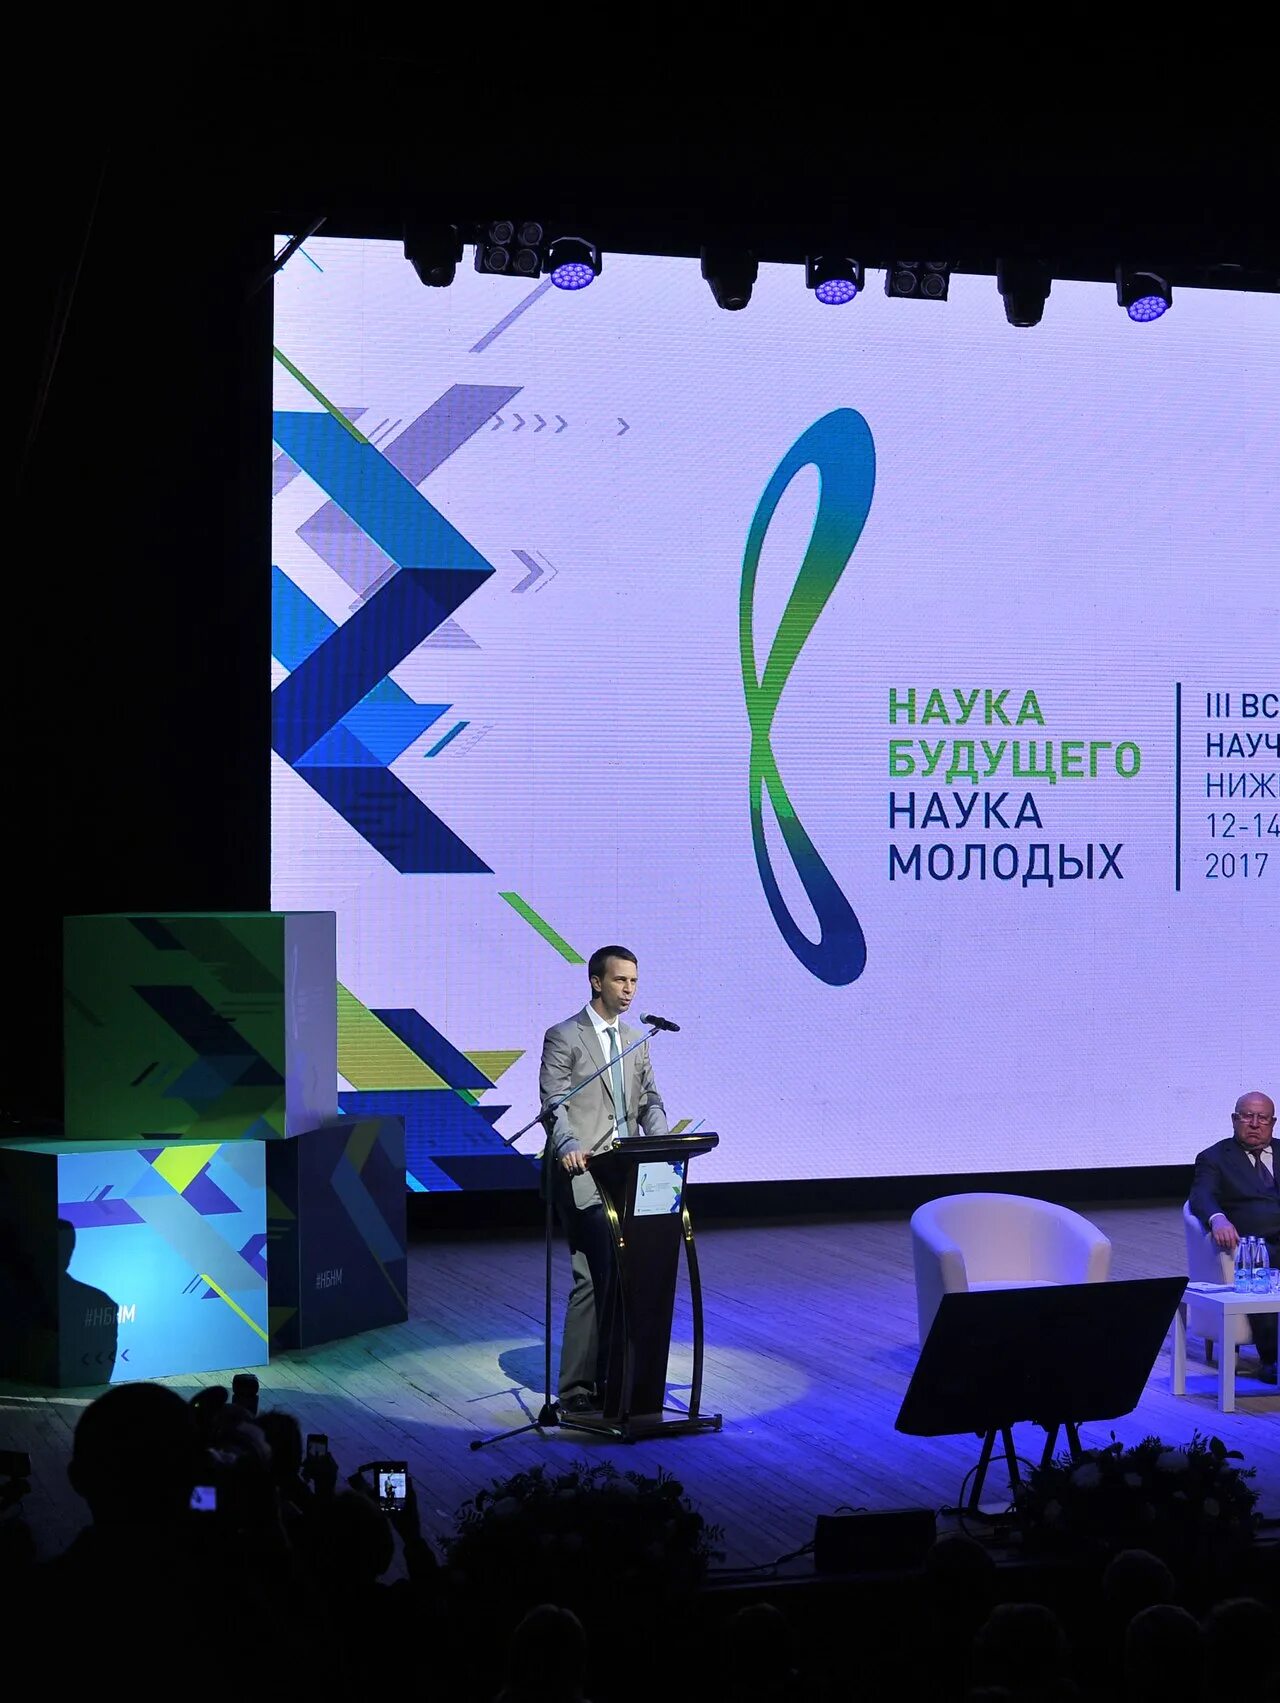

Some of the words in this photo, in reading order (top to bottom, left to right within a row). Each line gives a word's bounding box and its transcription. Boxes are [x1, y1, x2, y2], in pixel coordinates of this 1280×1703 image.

[889, 688, 1046, 726] НАУКА
[889, 740, 1141, 785] БУДУЩЕГО
[889, 792, 1043, 829] НАУКА
[1207, 812, 1280, 838] 12-14
[889, 843, 1124, 888] МОЛОДЫХ
[1205, 852, 1269, 880] 2017
